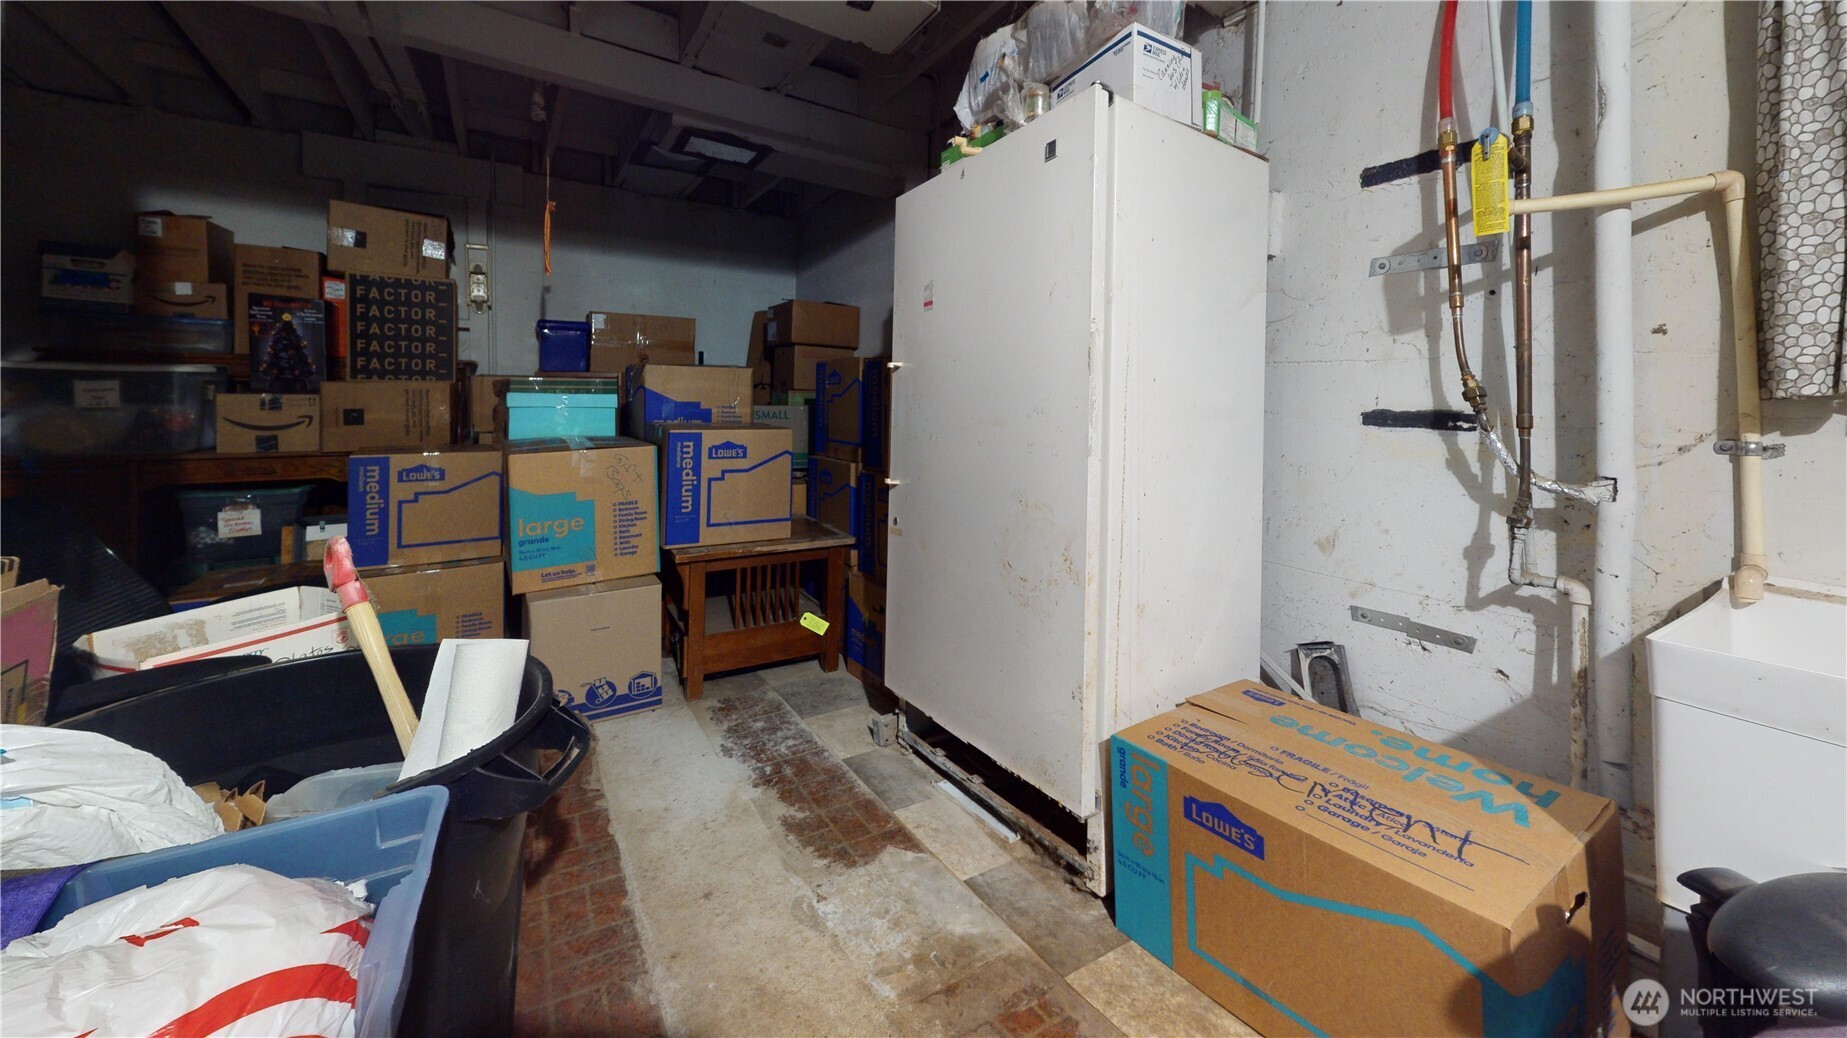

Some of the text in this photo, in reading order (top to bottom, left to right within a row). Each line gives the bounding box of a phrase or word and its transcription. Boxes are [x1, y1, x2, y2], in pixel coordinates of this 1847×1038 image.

[755, 410, 789, 420] SMALL
[712, 448, 744, 458] LOWE'S
[402, 470, 441, 480] LOWE'S
[681, 441, 697, 513] medium
[366, 465, 384, 536] medium
[518, 517, 585, 538] large
[518, 536, 550, 547] grande
[1155, 738, 1178, 751] Bath
[1189, 722, 1231, 742] Bedroom
[1236, 742, 1284, 765] Dormitorio
[1117, 746, 1128, 789] grande
[1206, 753, 1238, 771] Cocina
[1269, 714, 1531, 828] Welcome
[1280, 749, 1332, 775] FRAGILE
[1370, 729, 1561, 808] home.
[1124, 751, 1161, 858] large
[1325, 798, 1382, 827] Laundry
[1191, 802, 1256, 850] LOWE'S
[1317, 804, 1371, 832] Garage
[1381, 833, 1428, 858] Garaje
